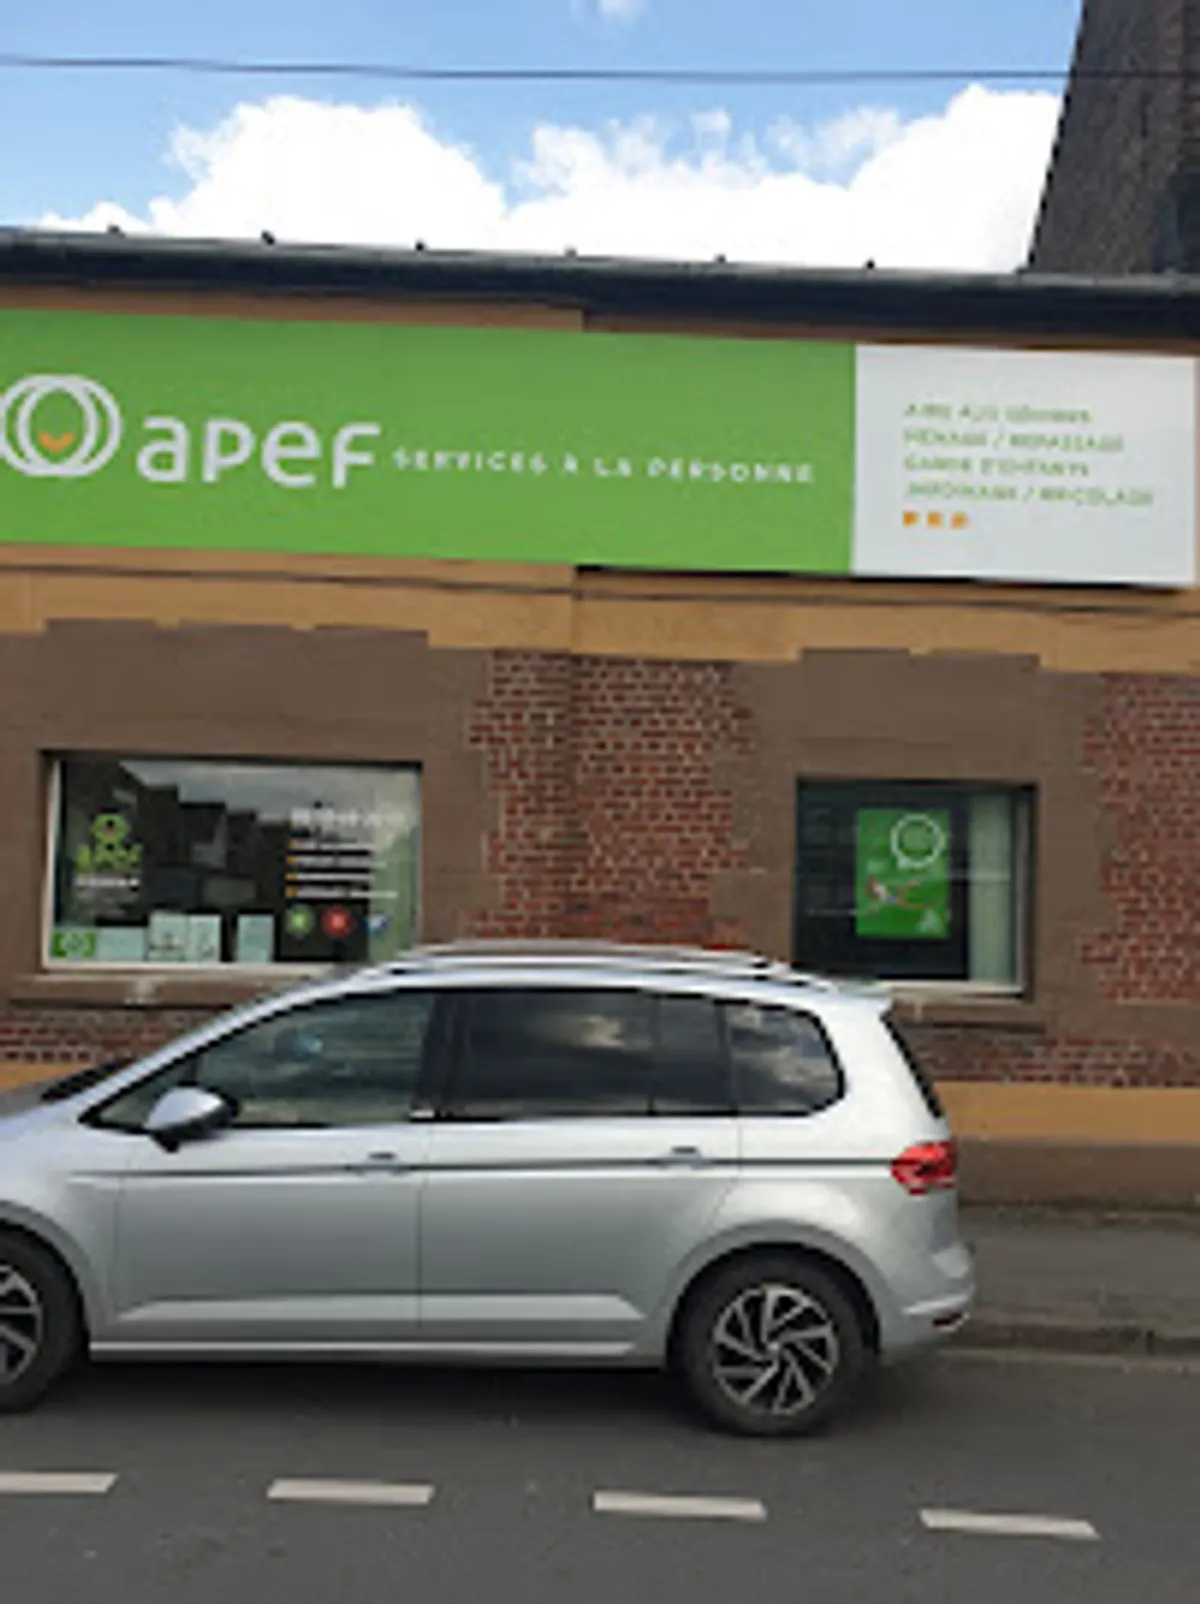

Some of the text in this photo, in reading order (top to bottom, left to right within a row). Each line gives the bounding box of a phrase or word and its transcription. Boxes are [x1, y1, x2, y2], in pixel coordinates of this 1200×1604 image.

[392, 446, 549, 475] SERVICES
[592, 456, 632, 477] LA
[647, 457, 815, 484] PERSONNE
